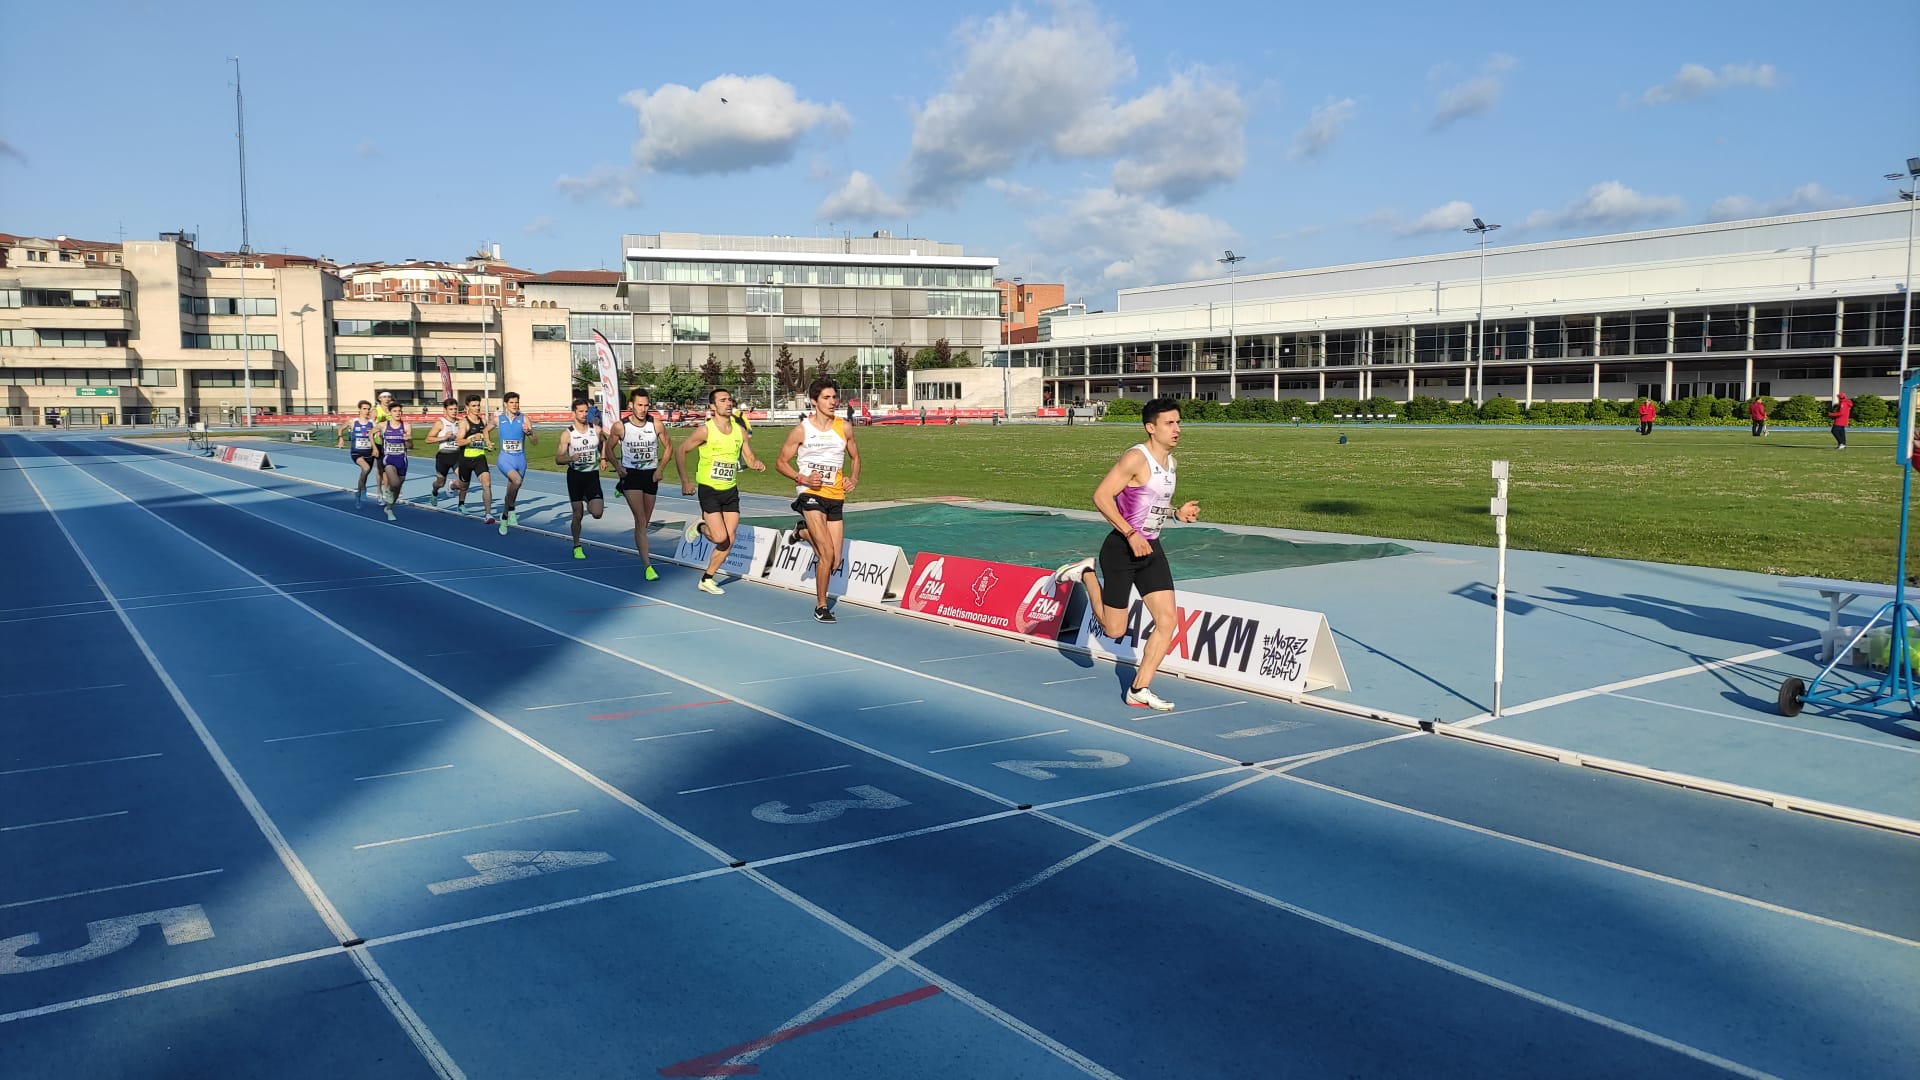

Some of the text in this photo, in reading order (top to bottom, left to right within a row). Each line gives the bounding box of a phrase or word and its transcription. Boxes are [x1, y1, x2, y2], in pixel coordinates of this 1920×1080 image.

[633, 452, 651, 460] 470
[713, 467, 733, 477] 1020
[811, 470, 831, 479] 64
[848, 560, 889, 586] PARK
[919, 593, 950, 602] ATLETISMO
[922, 580, 945, 596] FNA
[937, 603, 1009, 627] #atletismonavarro
[1032, 597, 1060, 616] FNA
[1027, 612, 1055, 622] ATLETISMO
[992, 748, 1131, 781] 2
[751, 784, 913, 826] 3
[427, 850, 615, 896] 4
[0, 903, 215, 974] 5
